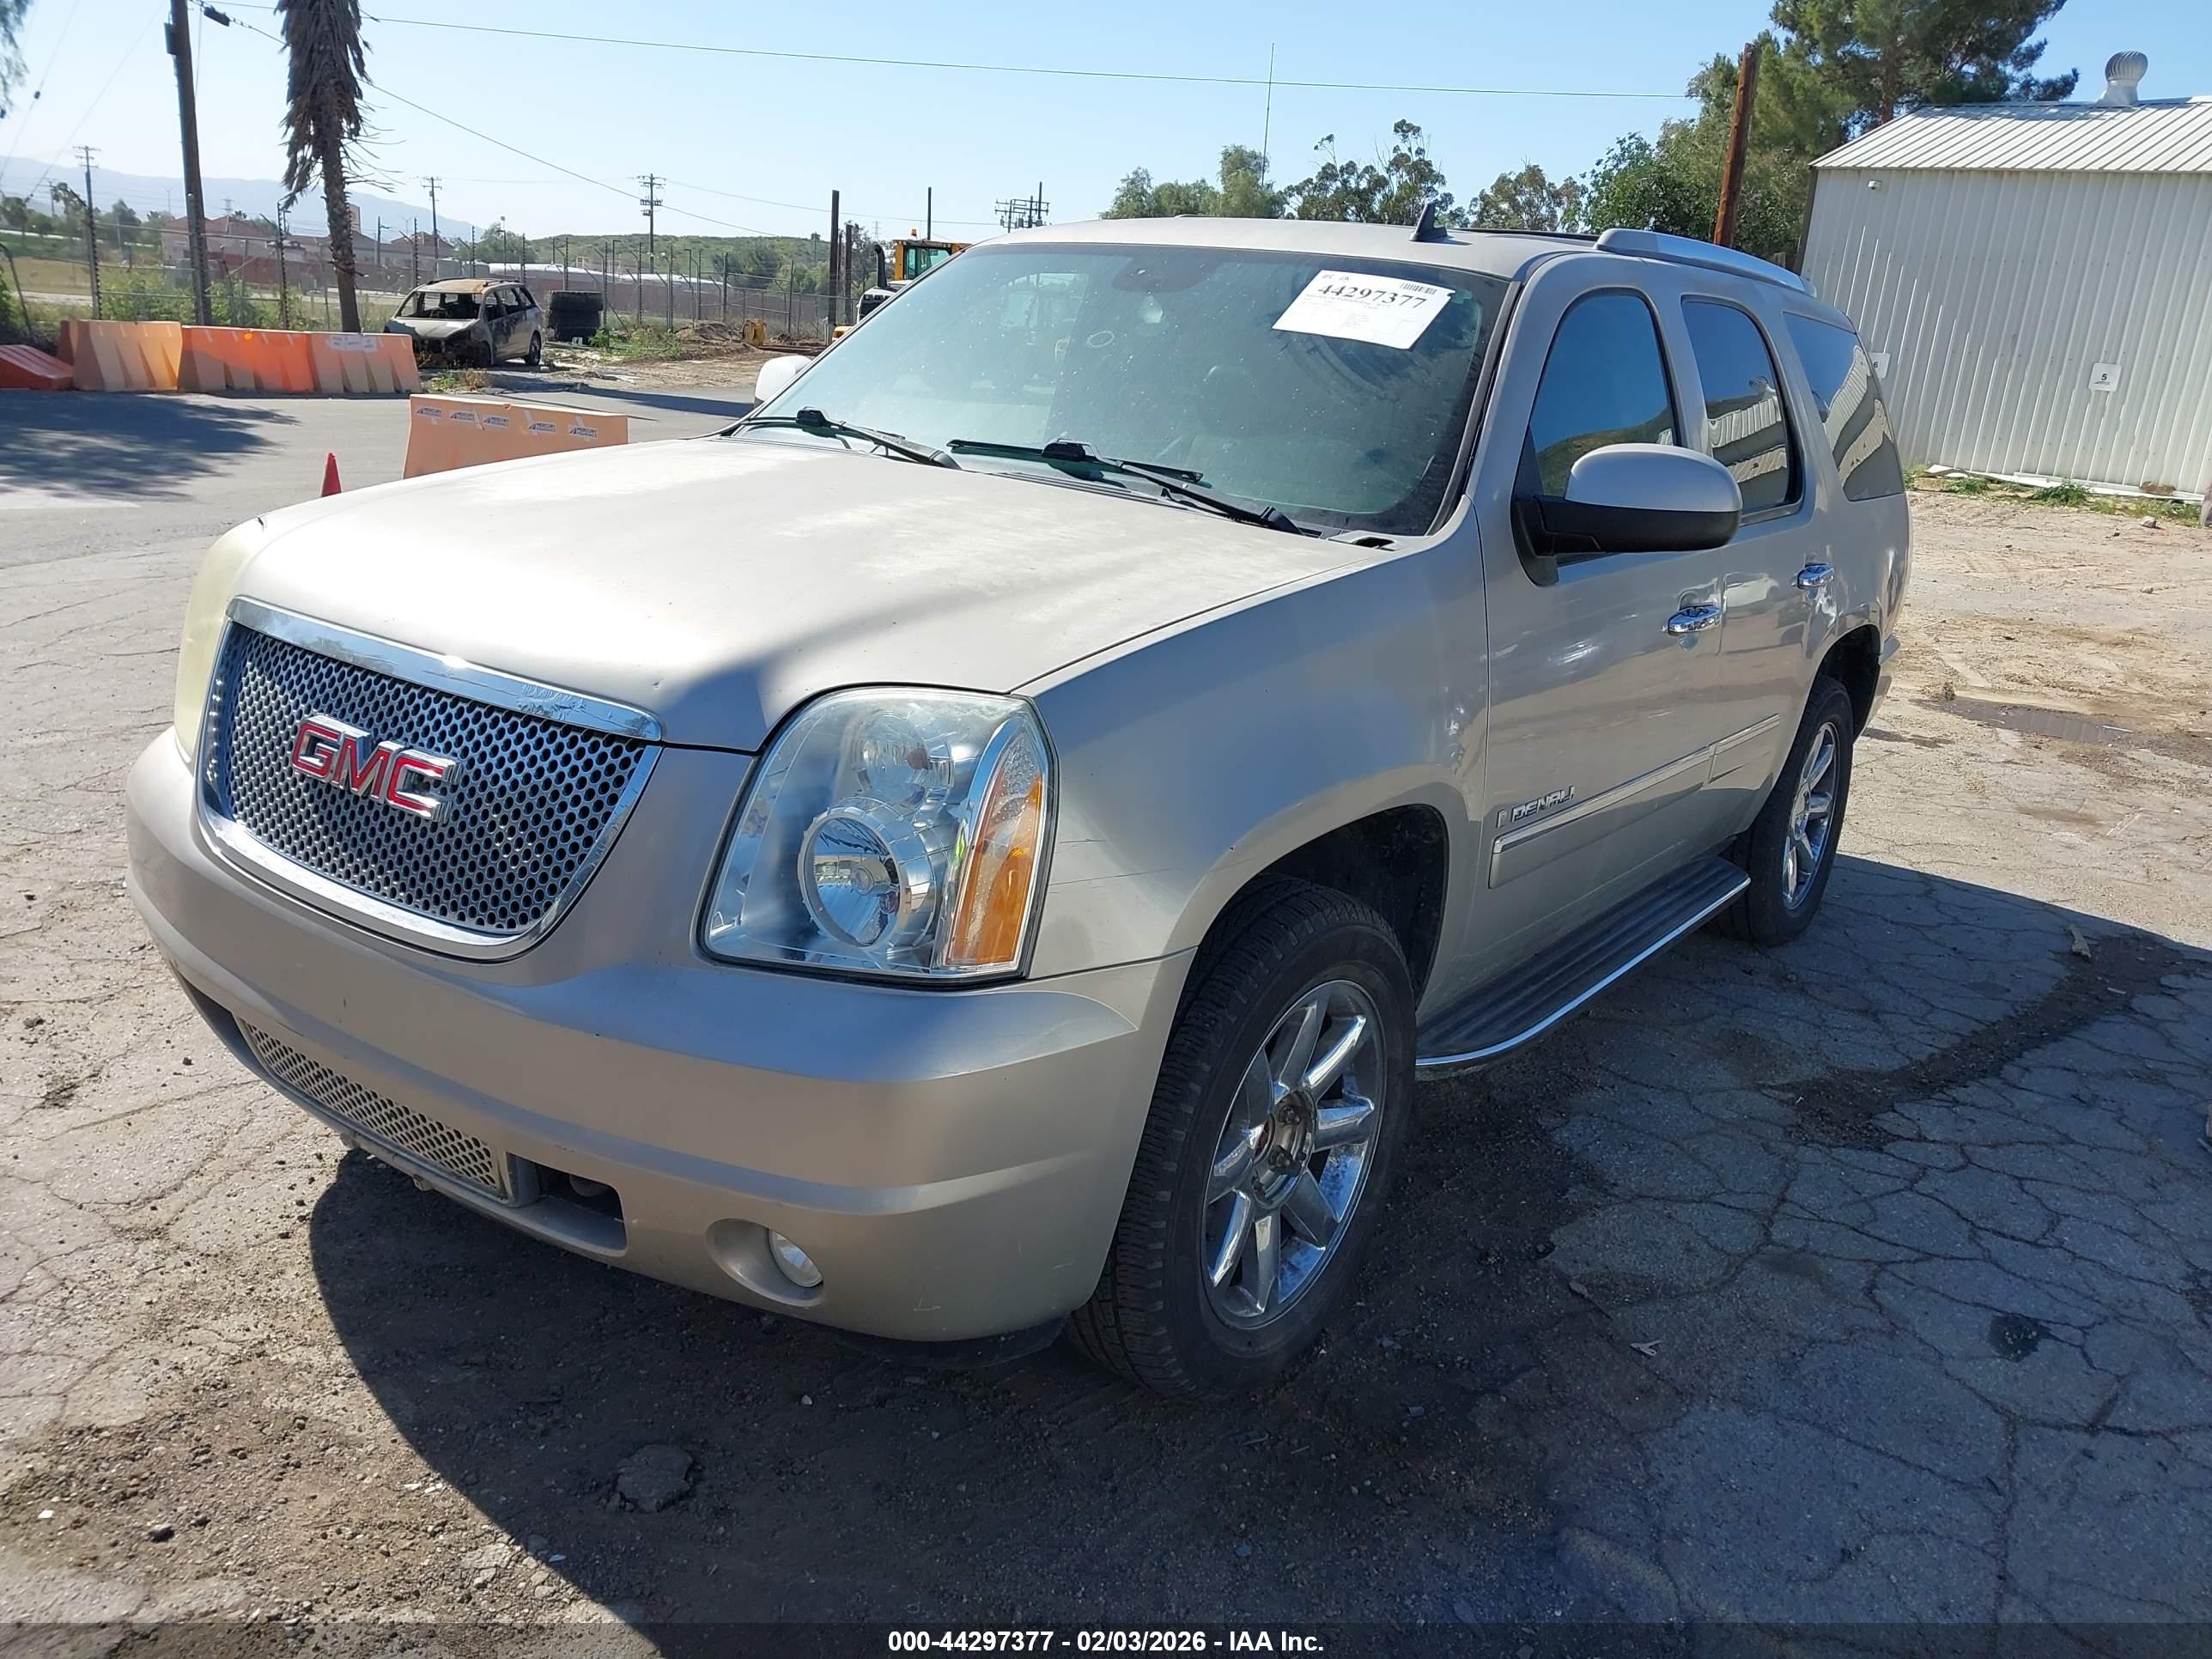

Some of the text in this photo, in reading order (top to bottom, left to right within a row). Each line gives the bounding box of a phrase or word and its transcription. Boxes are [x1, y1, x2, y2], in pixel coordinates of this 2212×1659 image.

[1318, 284, 1428, 308] 44297377
[2101, 373, 2108, 381] 5
[291, 714, 463, 822] GMC
[1511, 786, 1575, 823] DENALI
